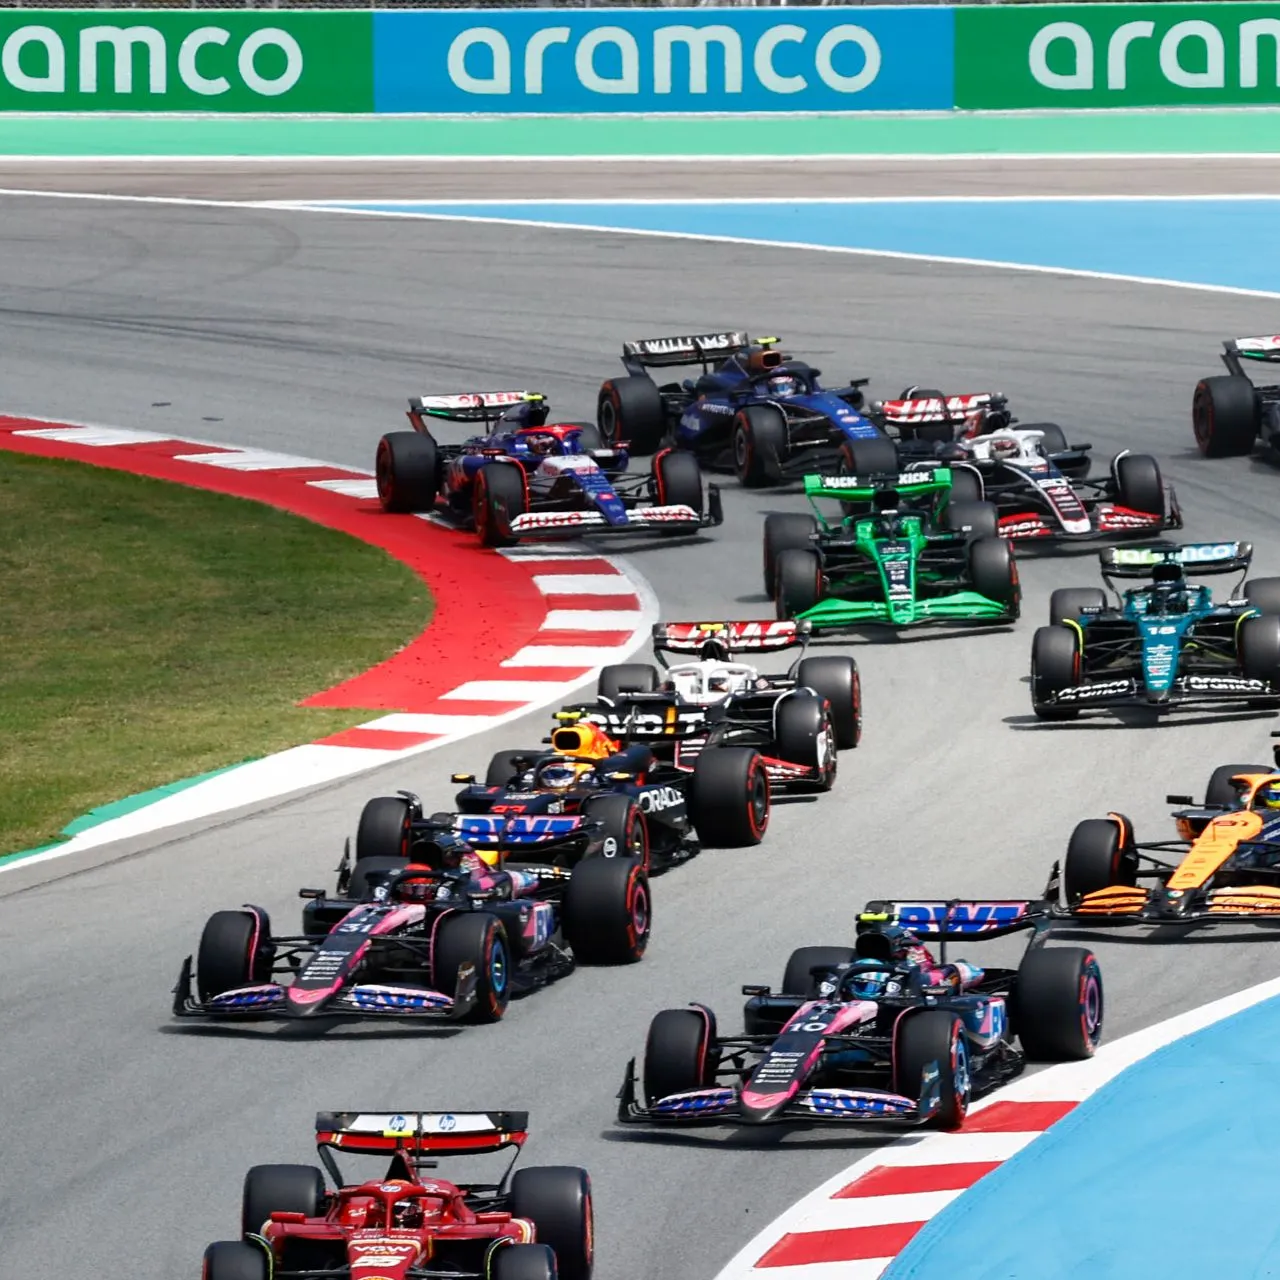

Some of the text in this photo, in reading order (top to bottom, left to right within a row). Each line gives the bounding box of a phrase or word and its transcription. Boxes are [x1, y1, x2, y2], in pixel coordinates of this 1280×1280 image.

[448, 25, 880, 93] aramco
[521, 512, 582, 529] HUGO
[1113, 543, 1233, 565] armco
[638, 787, 685, 814] ORACLE
[789, 1022, 829, 1032] 10
[388, 1114, 407, 1131] hp
[439, 1114, 457, 1131] hp
